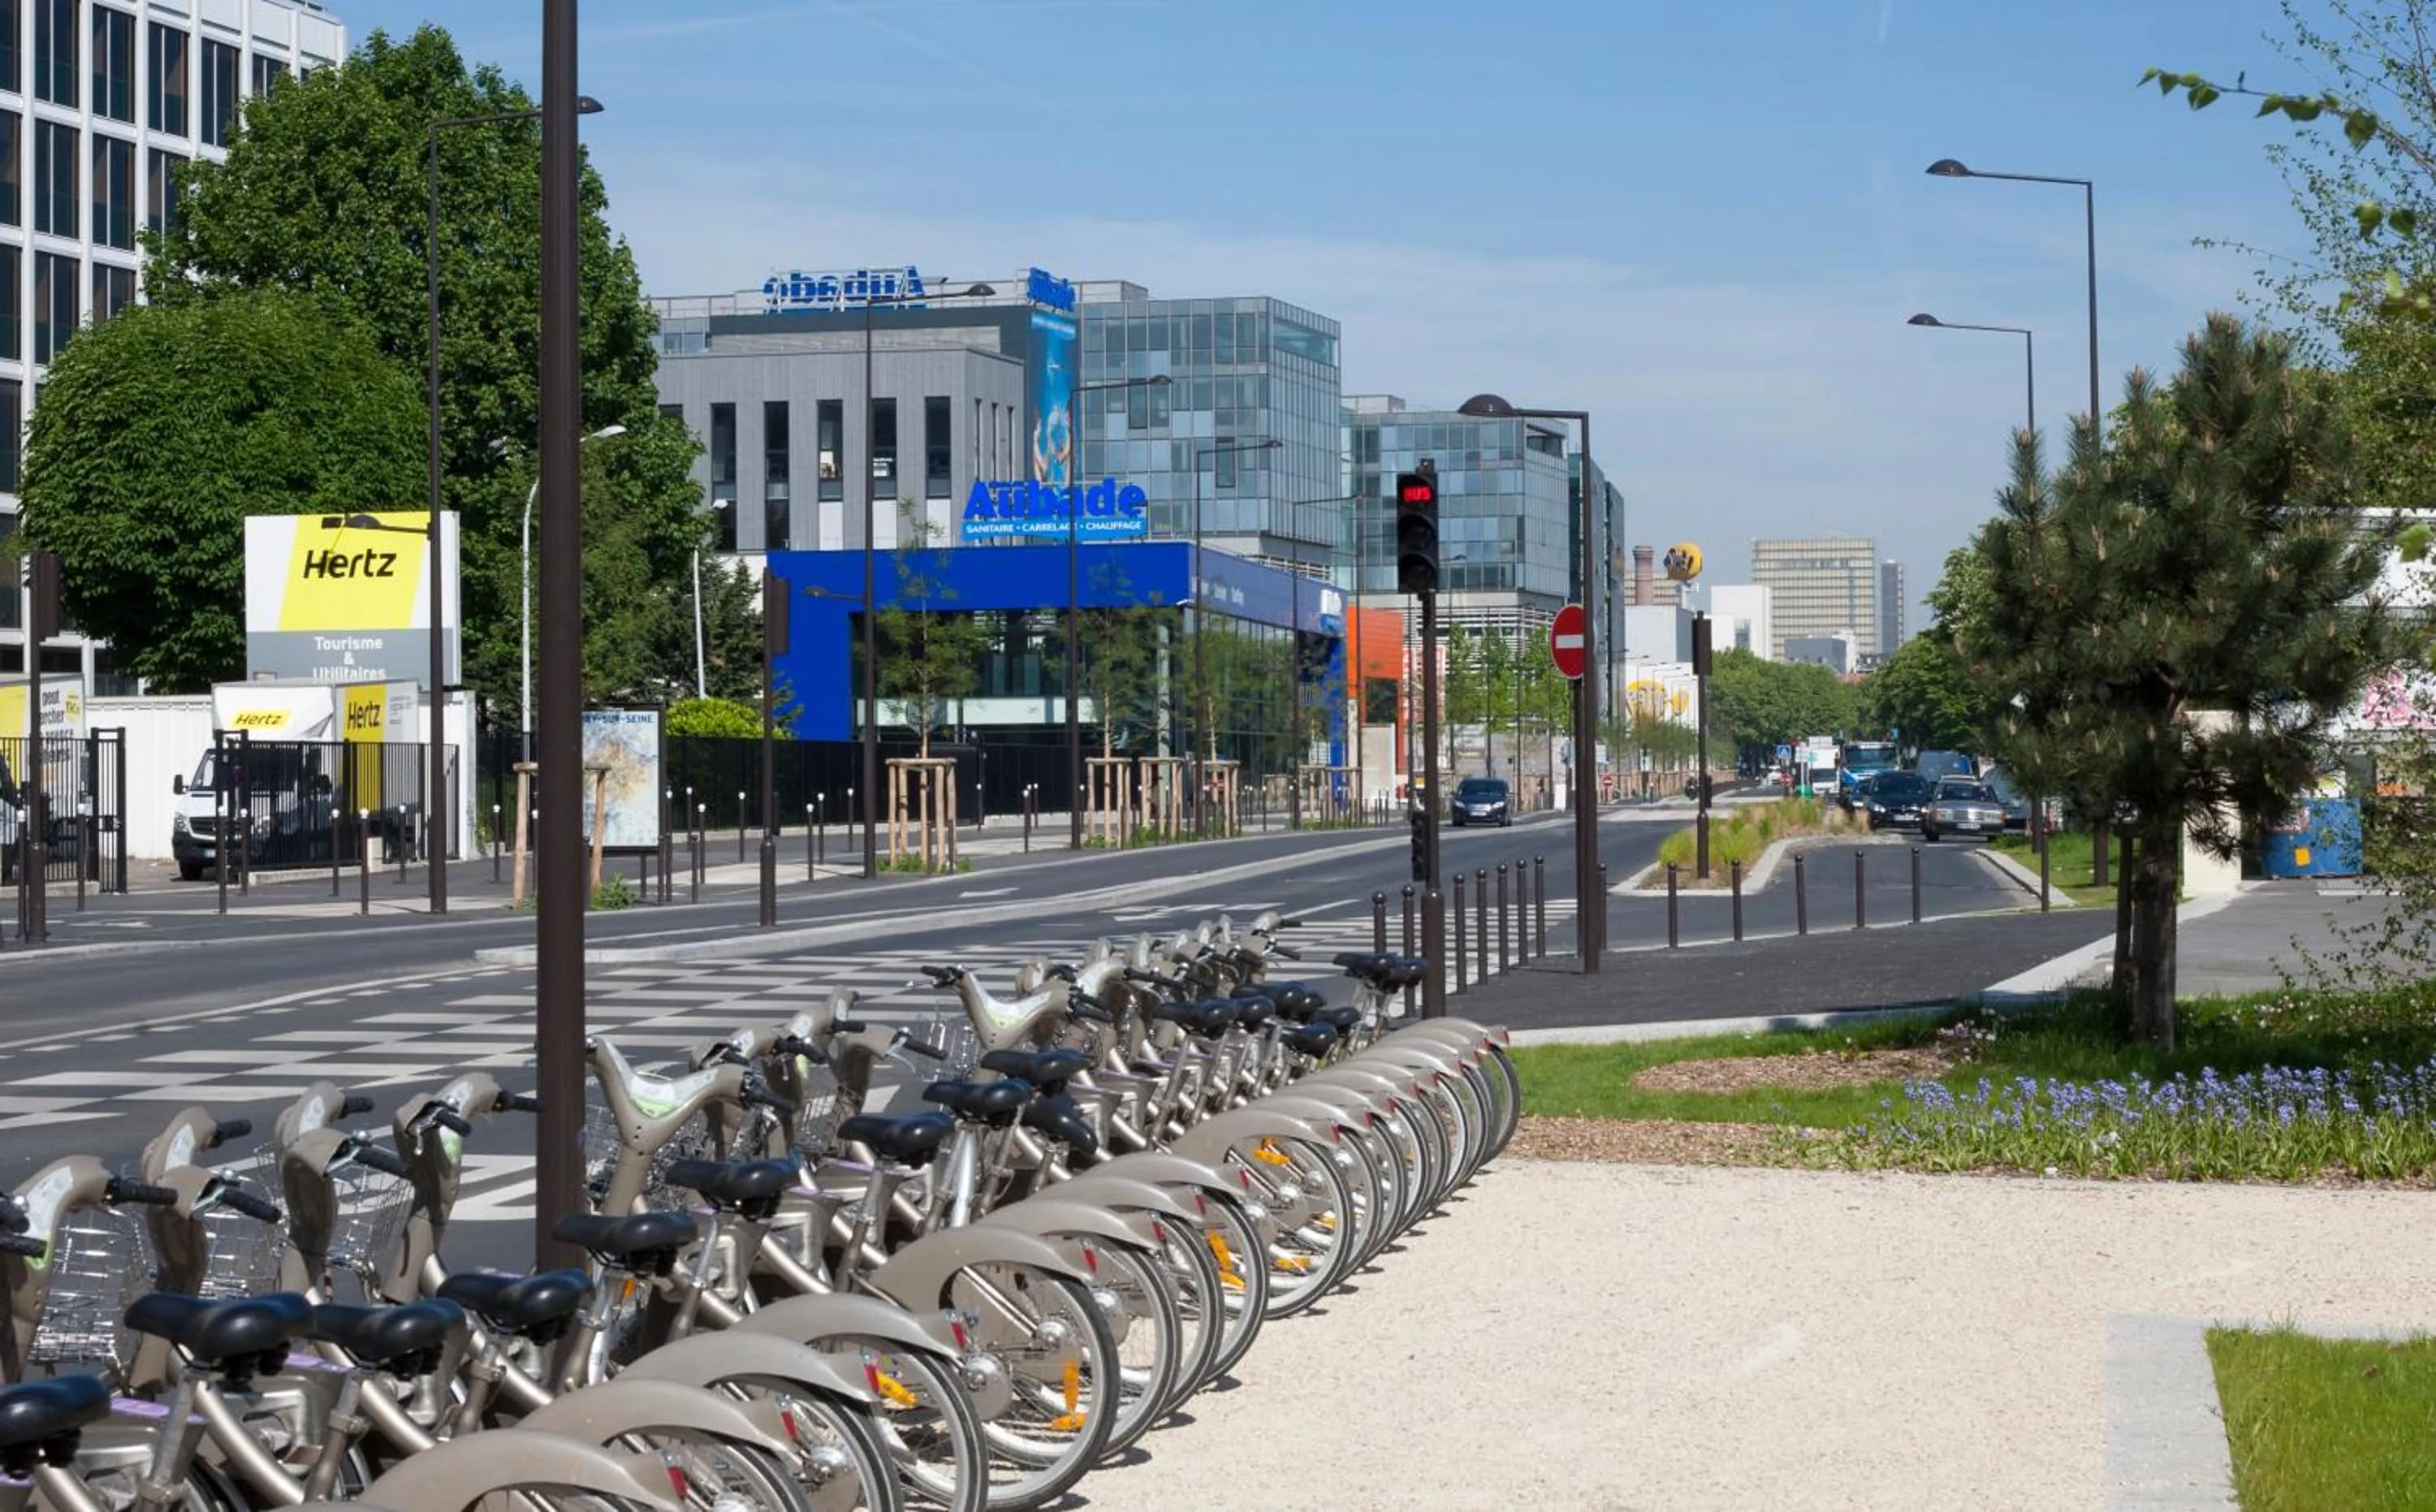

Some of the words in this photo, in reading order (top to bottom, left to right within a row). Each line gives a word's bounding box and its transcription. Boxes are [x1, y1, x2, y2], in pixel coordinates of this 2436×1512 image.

[963, 475, 1147, 519] Aubade
[1403, 486, 1431, 501] BUS
[966, 524, 1013, 533] SANITAIRE
[1086, 521, 1142, 530] CHAUFFAGE
[303, 548, 397, 579] Hertz
[313, 636, 384, 650] Tourisme
[343, 651, 355, 665] &
[313, 667, 387, 682] Utilitaires
[236, 713, 283, 726] Hertz
[348, 702, 382, 730] Hertz
